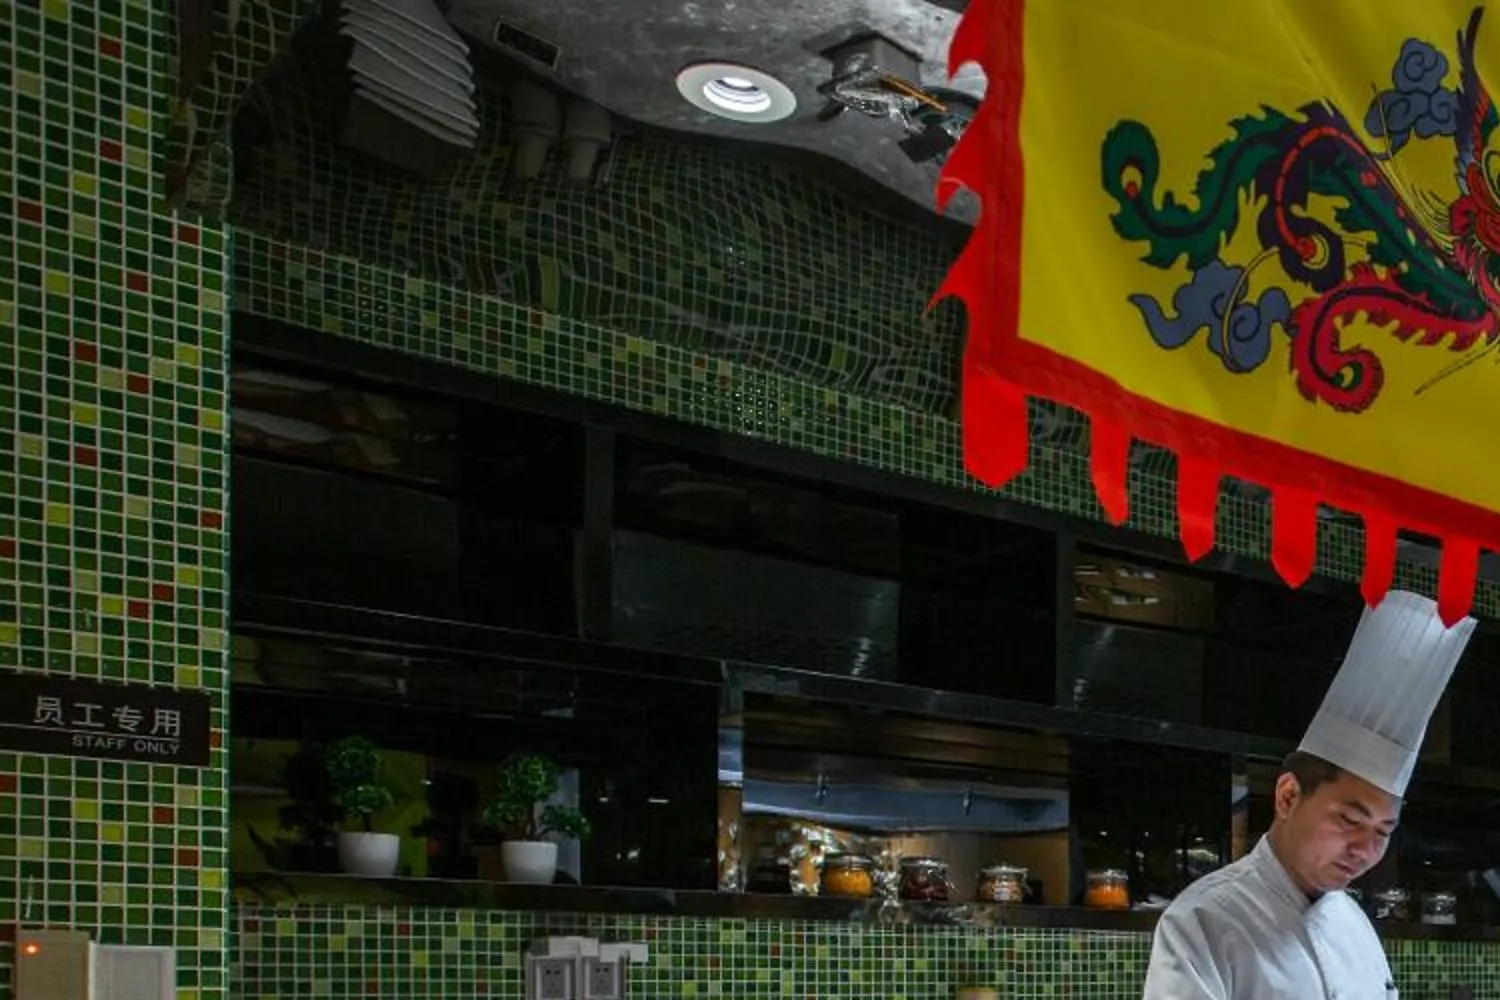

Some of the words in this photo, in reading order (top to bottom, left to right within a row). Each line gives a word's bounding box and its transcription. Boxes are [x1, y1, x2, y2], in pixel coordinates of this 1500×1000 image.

[33, 694, 182, 737] 员工专用
[71, 733, 127, 750] STAFF
[133, 739, 181, 755] ONLY
